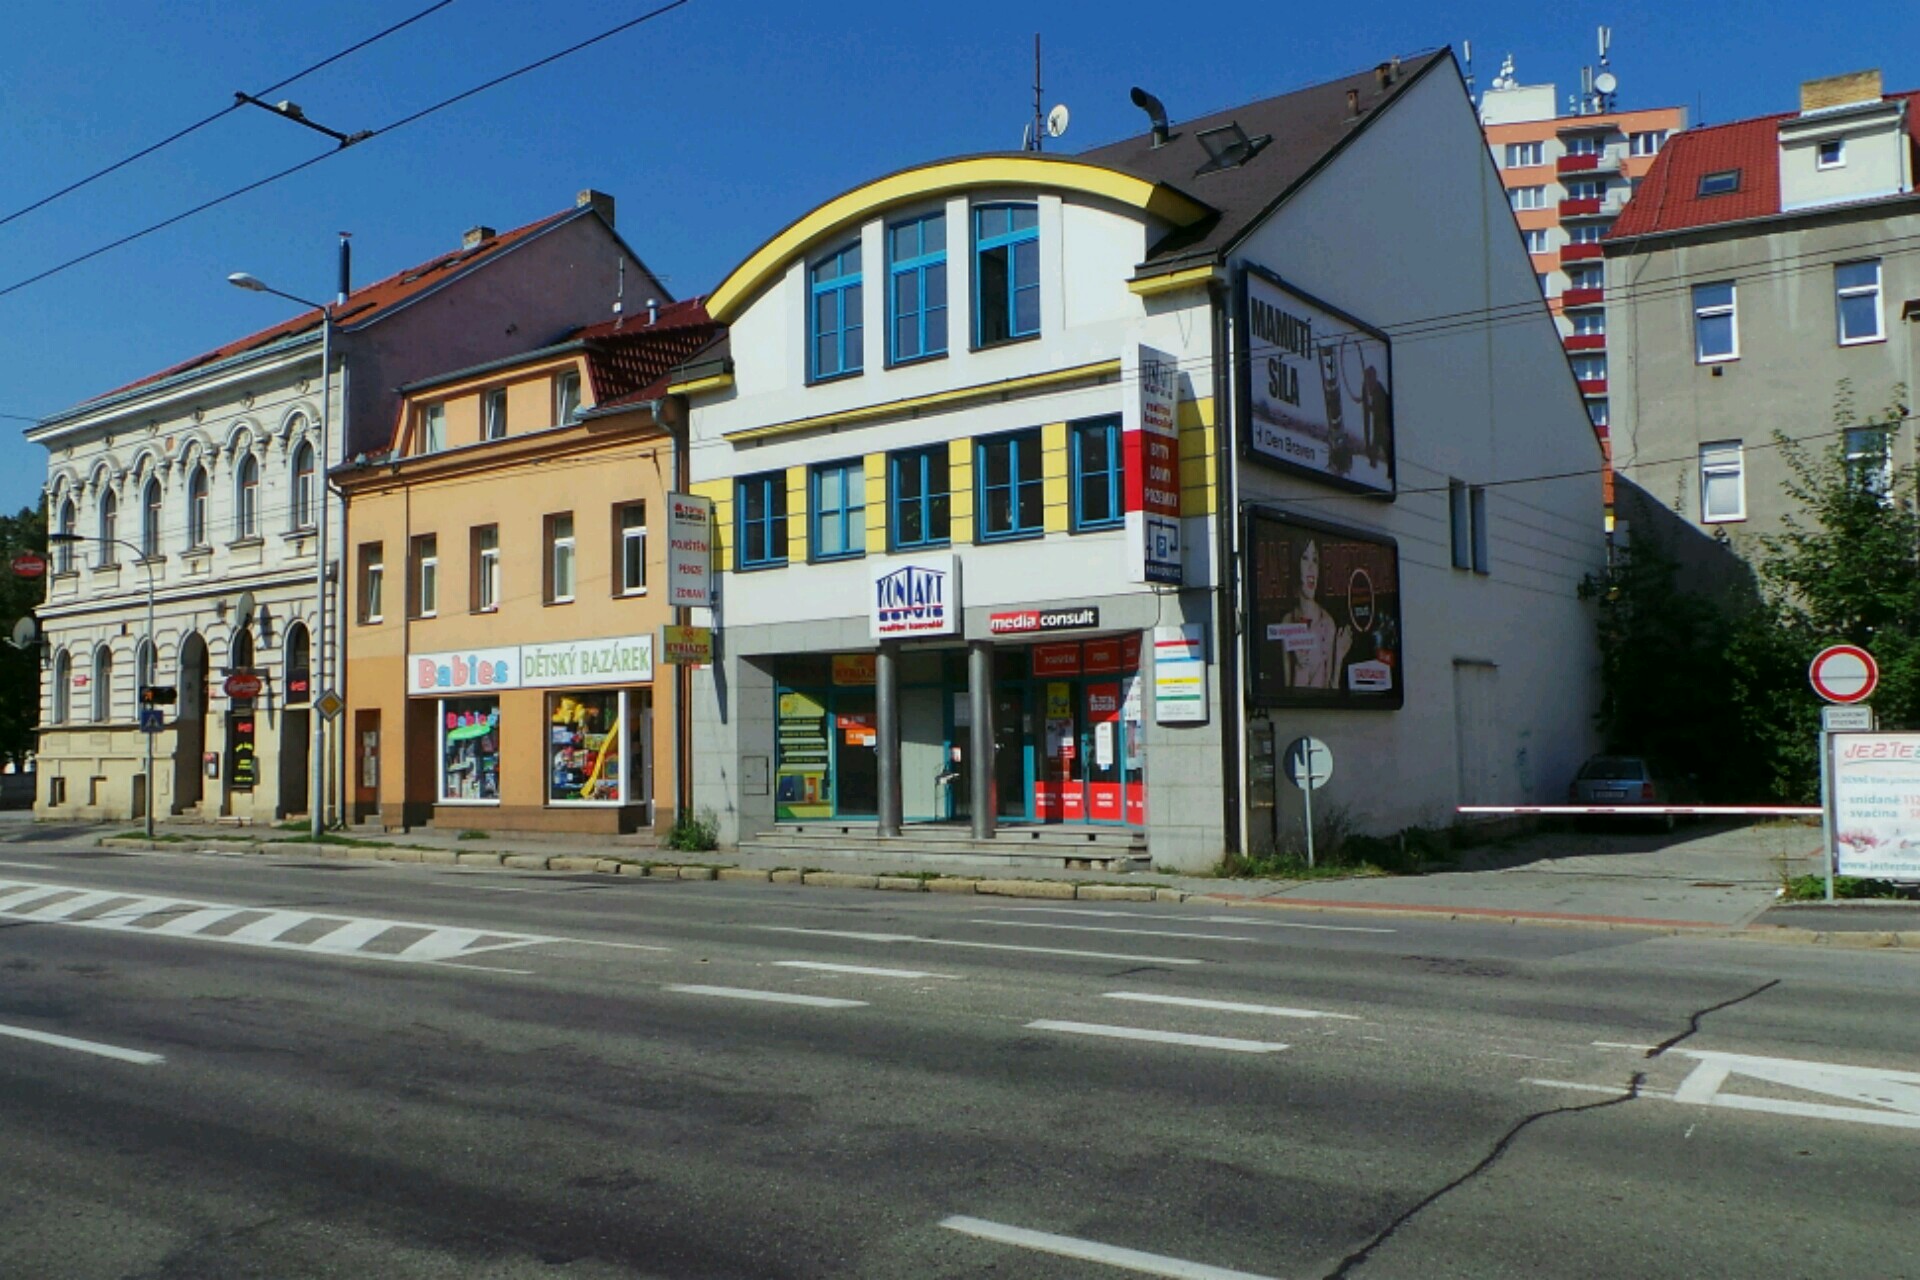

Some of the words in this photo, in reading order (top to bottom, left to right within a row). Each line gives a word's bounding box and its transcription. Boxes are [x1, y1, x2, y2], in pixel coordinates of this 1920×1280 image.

[1251, 296, 1311, 360] MAMUTÍ
[1268, 354, 1299, 407] SÍLA
[1265, 430, 1283, 449] Den
[1285, 436, 1315, 460] Braven
[876, 566, 946, 608] KONTAKT
[992, 614, 1037, 629] media
[1041, 609, 1094, 626] consult
[418, 655, 508, 688] Babies
[525, 646, 576, 679] DĚTSKÝ
[581, 641, 650, 674] BAZÁREK
